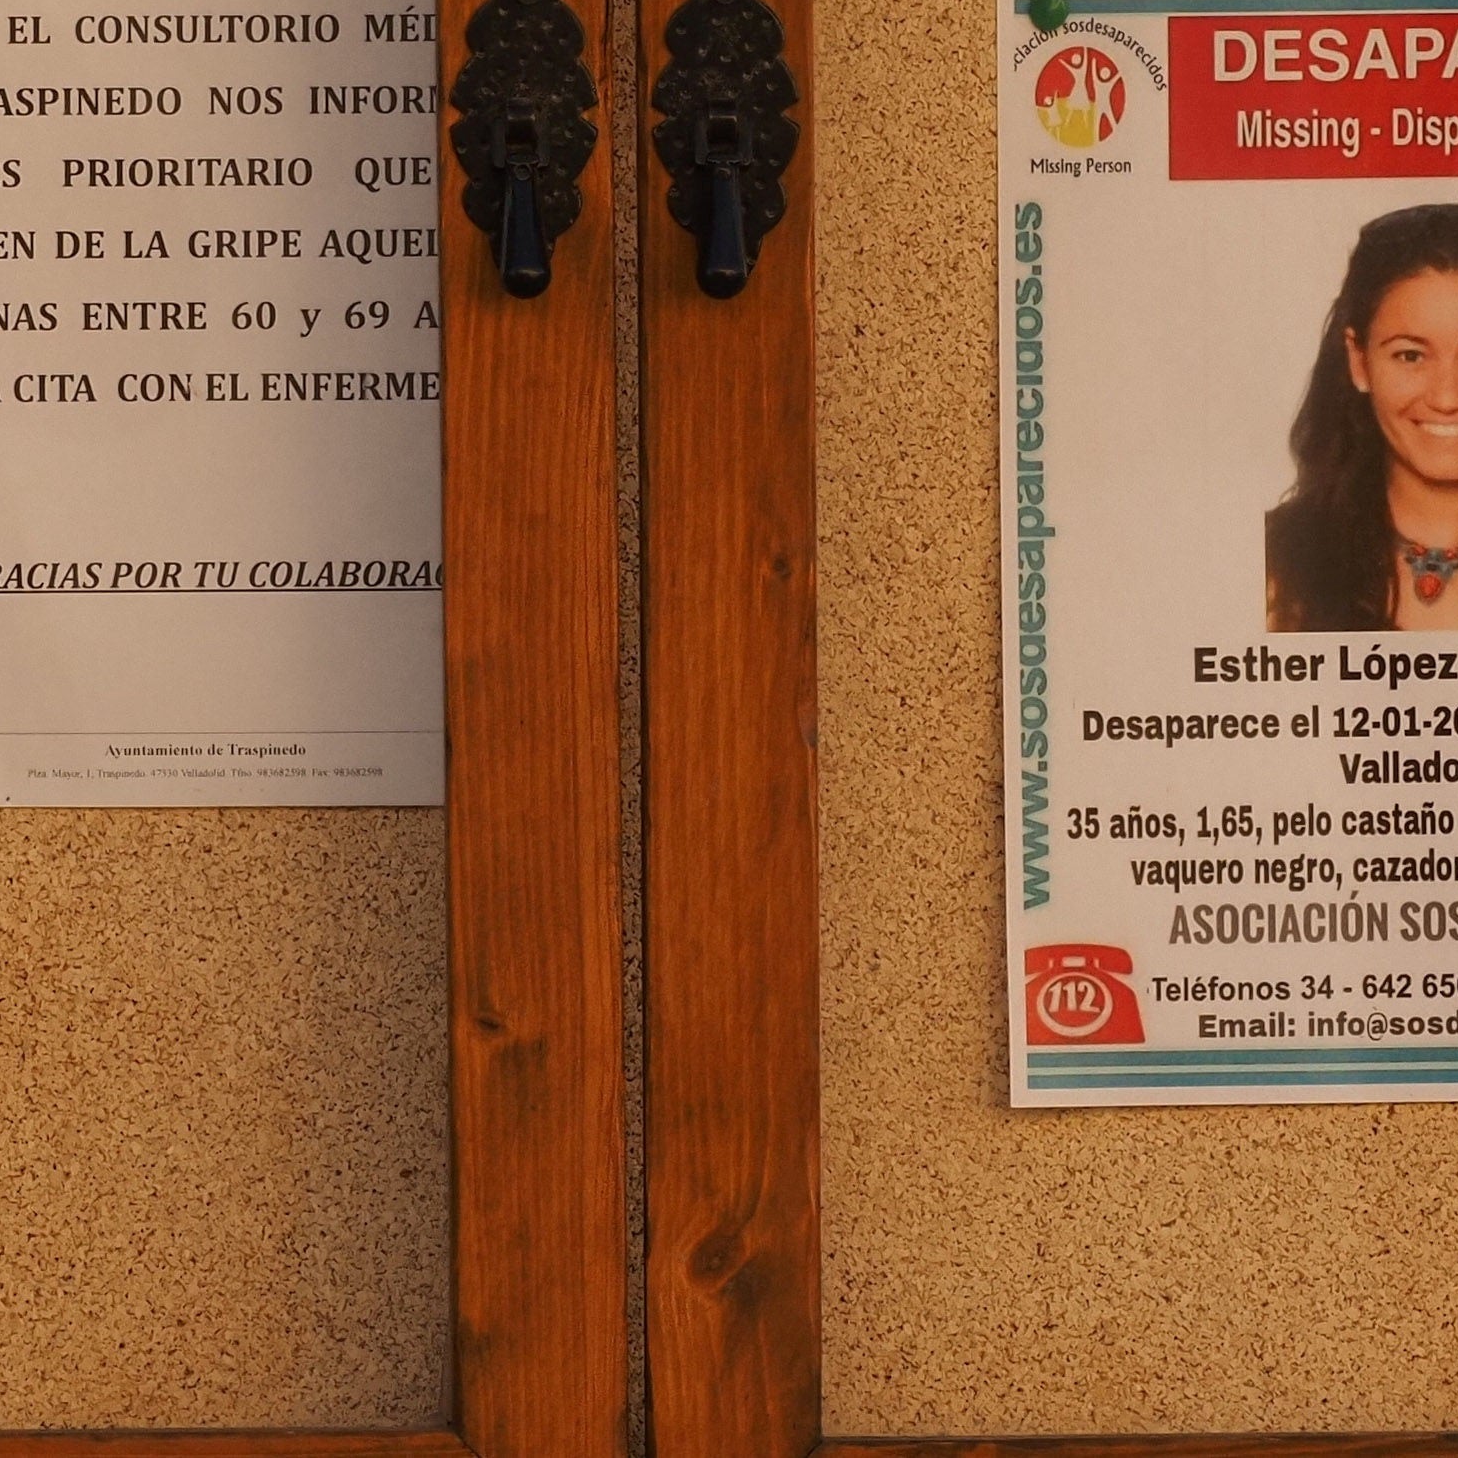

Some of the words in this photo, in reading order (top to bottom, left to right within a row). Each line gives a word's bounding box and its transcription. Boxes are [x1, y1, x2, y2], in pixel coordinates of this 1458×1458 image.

[1061, 17, 1168, 92] sosdesaparecidos
[1237, 110, 1359, 155] Missing
[1030, 158, 1081, 178] Missing
[1086, 158, 1131, 173] Person
[83, 302, 206, 330] ENTRE
[232, 302, 276, 329] 60
[300, 309, 321, 337] y
[345, 301, 389, 329] 69
[110, 562, 182, 588] POR
[194, 562, 239, 588] TU
[1194, 646, 1325, 682] Esther
[1340, 644, 1458, 689] López
[1083, 711, 1279, 745] Desaparece
[1291, 706, 1319, 738] el
[1169, 890, 1388, 944] ASOCIACIÓN
[1046, 979, 1100, 1013] 112
[1199, 1012, 1295, 1038] Email:
